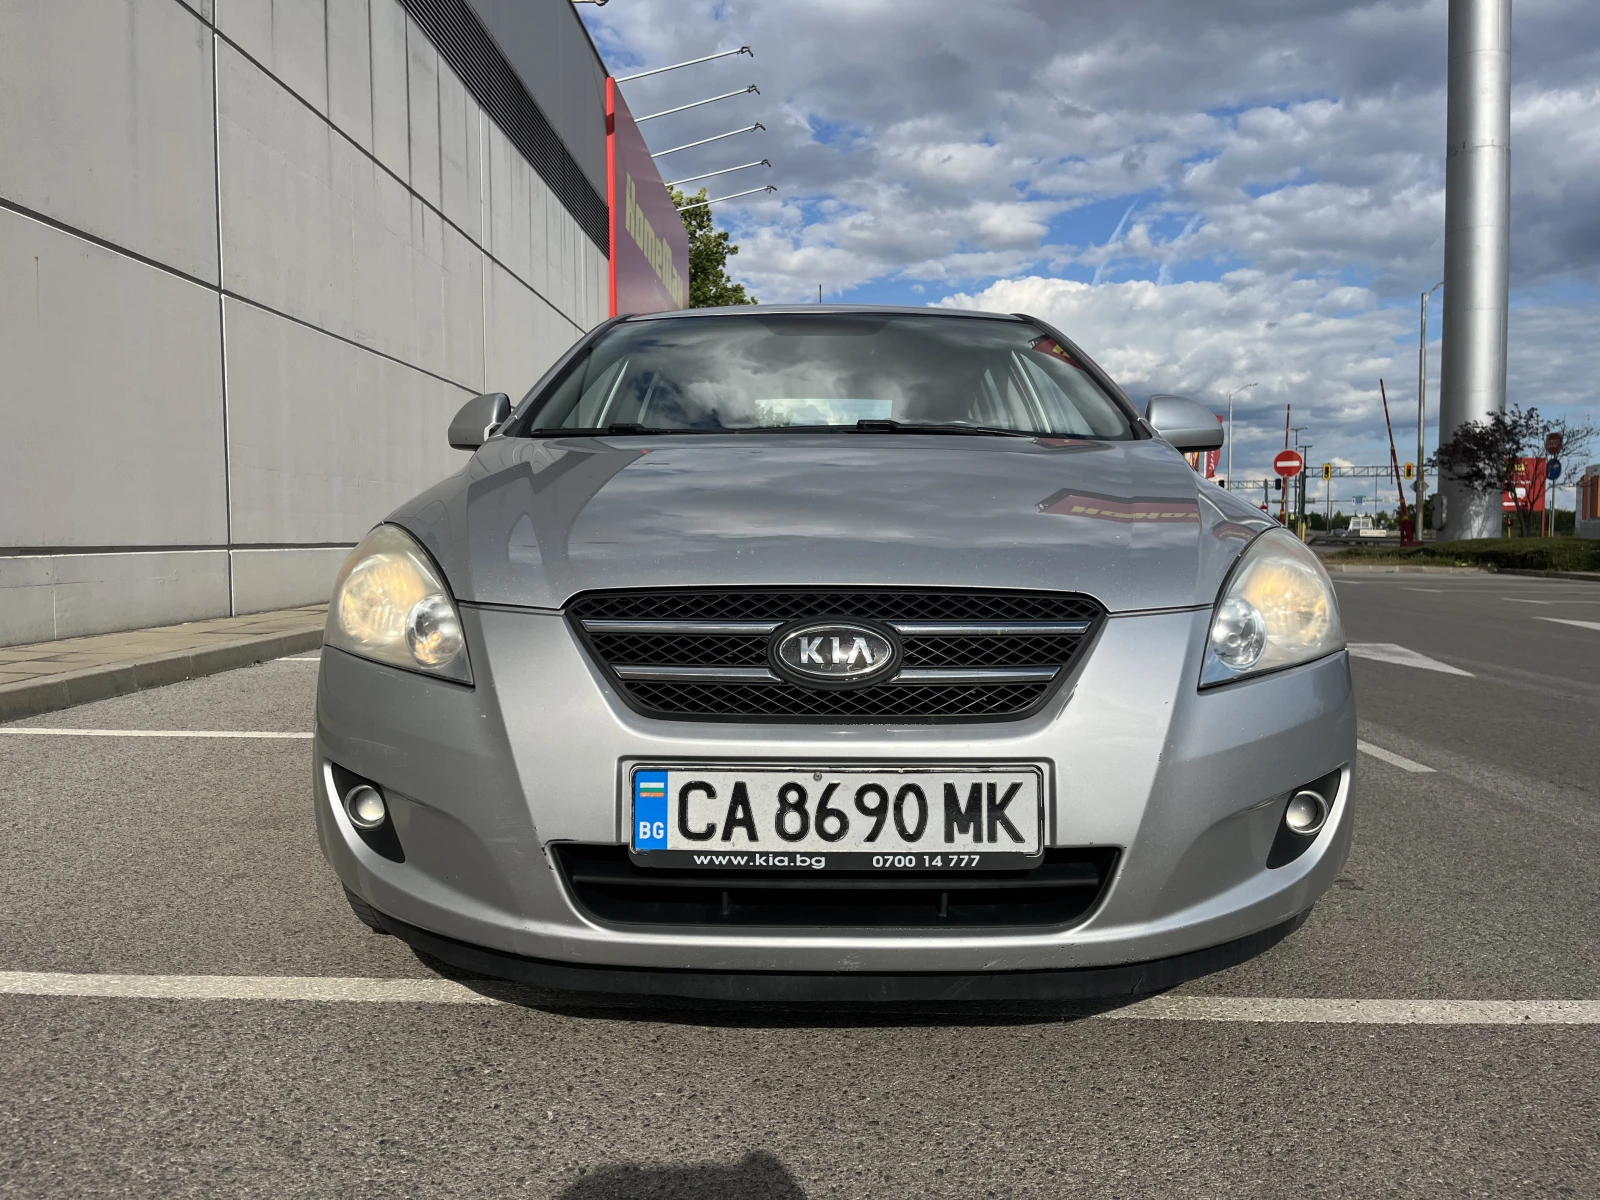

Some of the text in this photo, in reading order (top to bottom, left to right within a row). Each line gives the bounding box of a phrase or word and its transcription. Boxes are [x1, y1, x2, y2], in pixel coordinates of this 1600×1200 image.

[798, 636, 874, 664] KIA
[677, 779, 1026, 843] CA 8690 MK
[639, 821, 665, 840] BG
[693, 853, 826, 869] www.kia.bg
[872, 855, 981, 868] 0700 14 777
